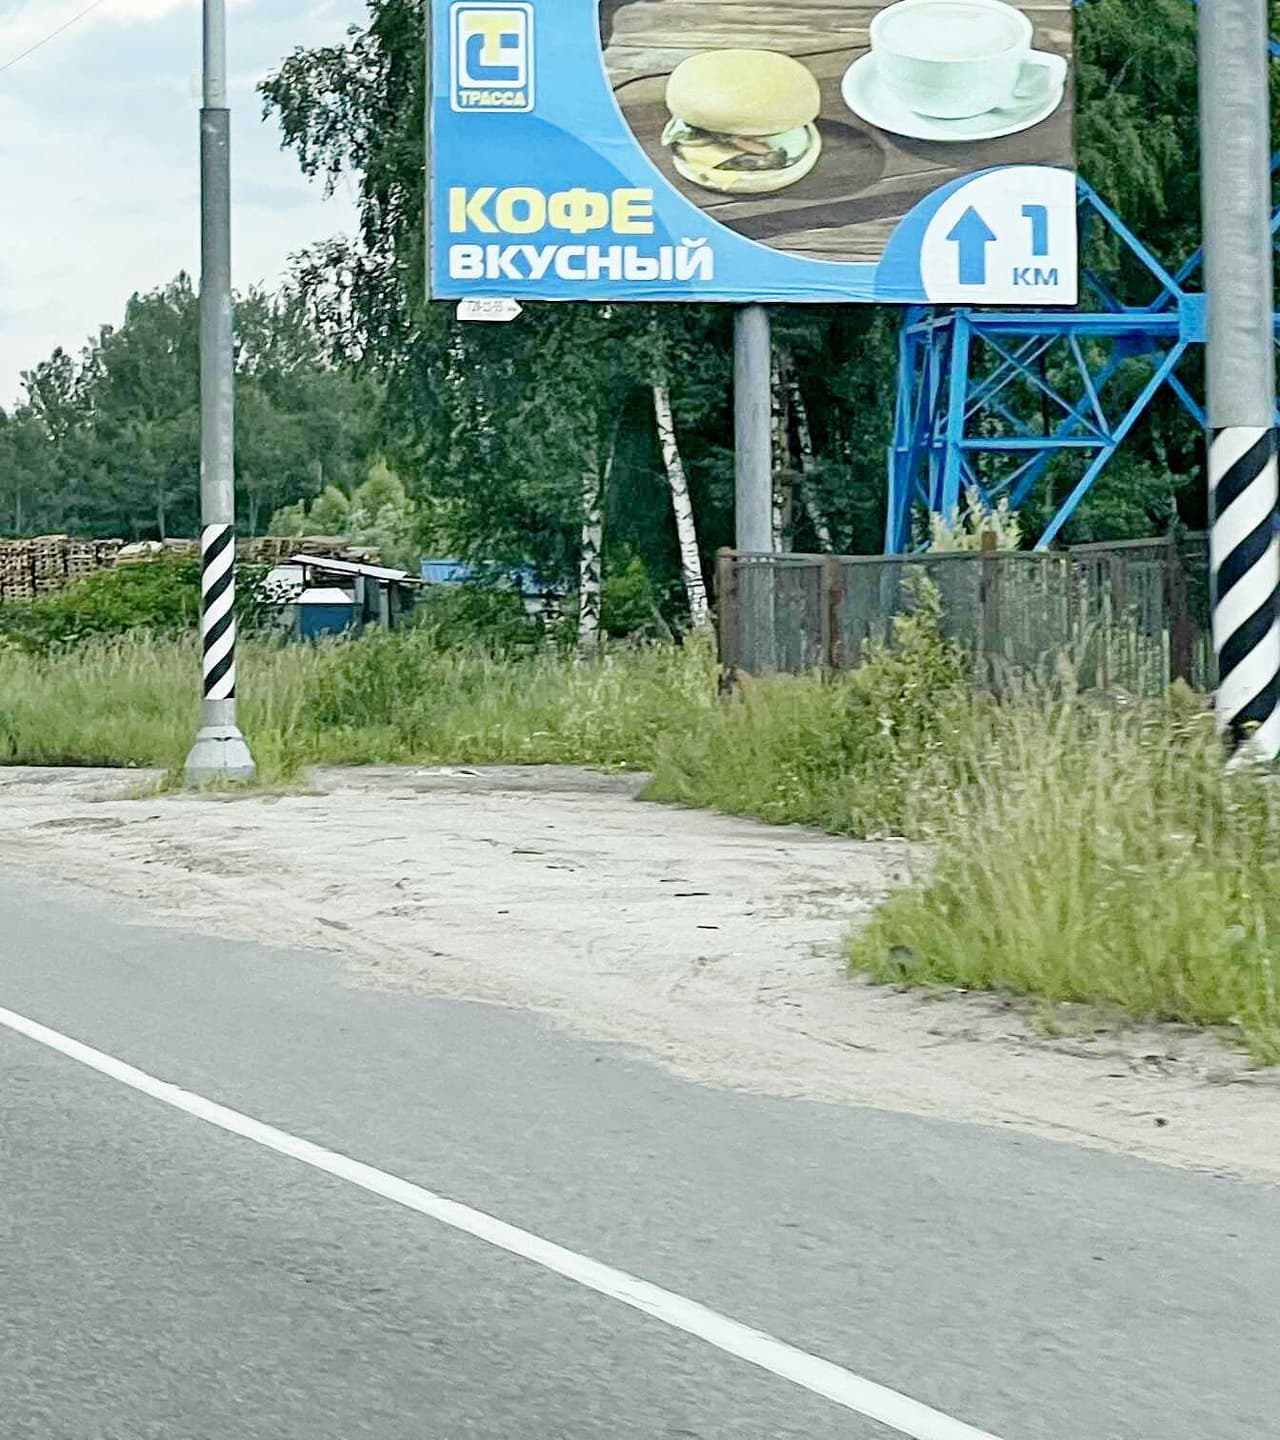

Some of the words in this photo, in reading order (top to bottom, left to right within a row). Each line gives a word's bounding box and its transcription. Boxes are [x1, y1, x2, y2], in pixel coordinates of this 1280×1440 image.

[459, 91, 526, 106] ТРАССА
[449, 187, 653, 234] КОФЕ
[1021, 204, 1048, 256] 1
[449, 237, 714, 281] ВКУСНЫЙ
[1013, 267, 1058, 286] КМ
